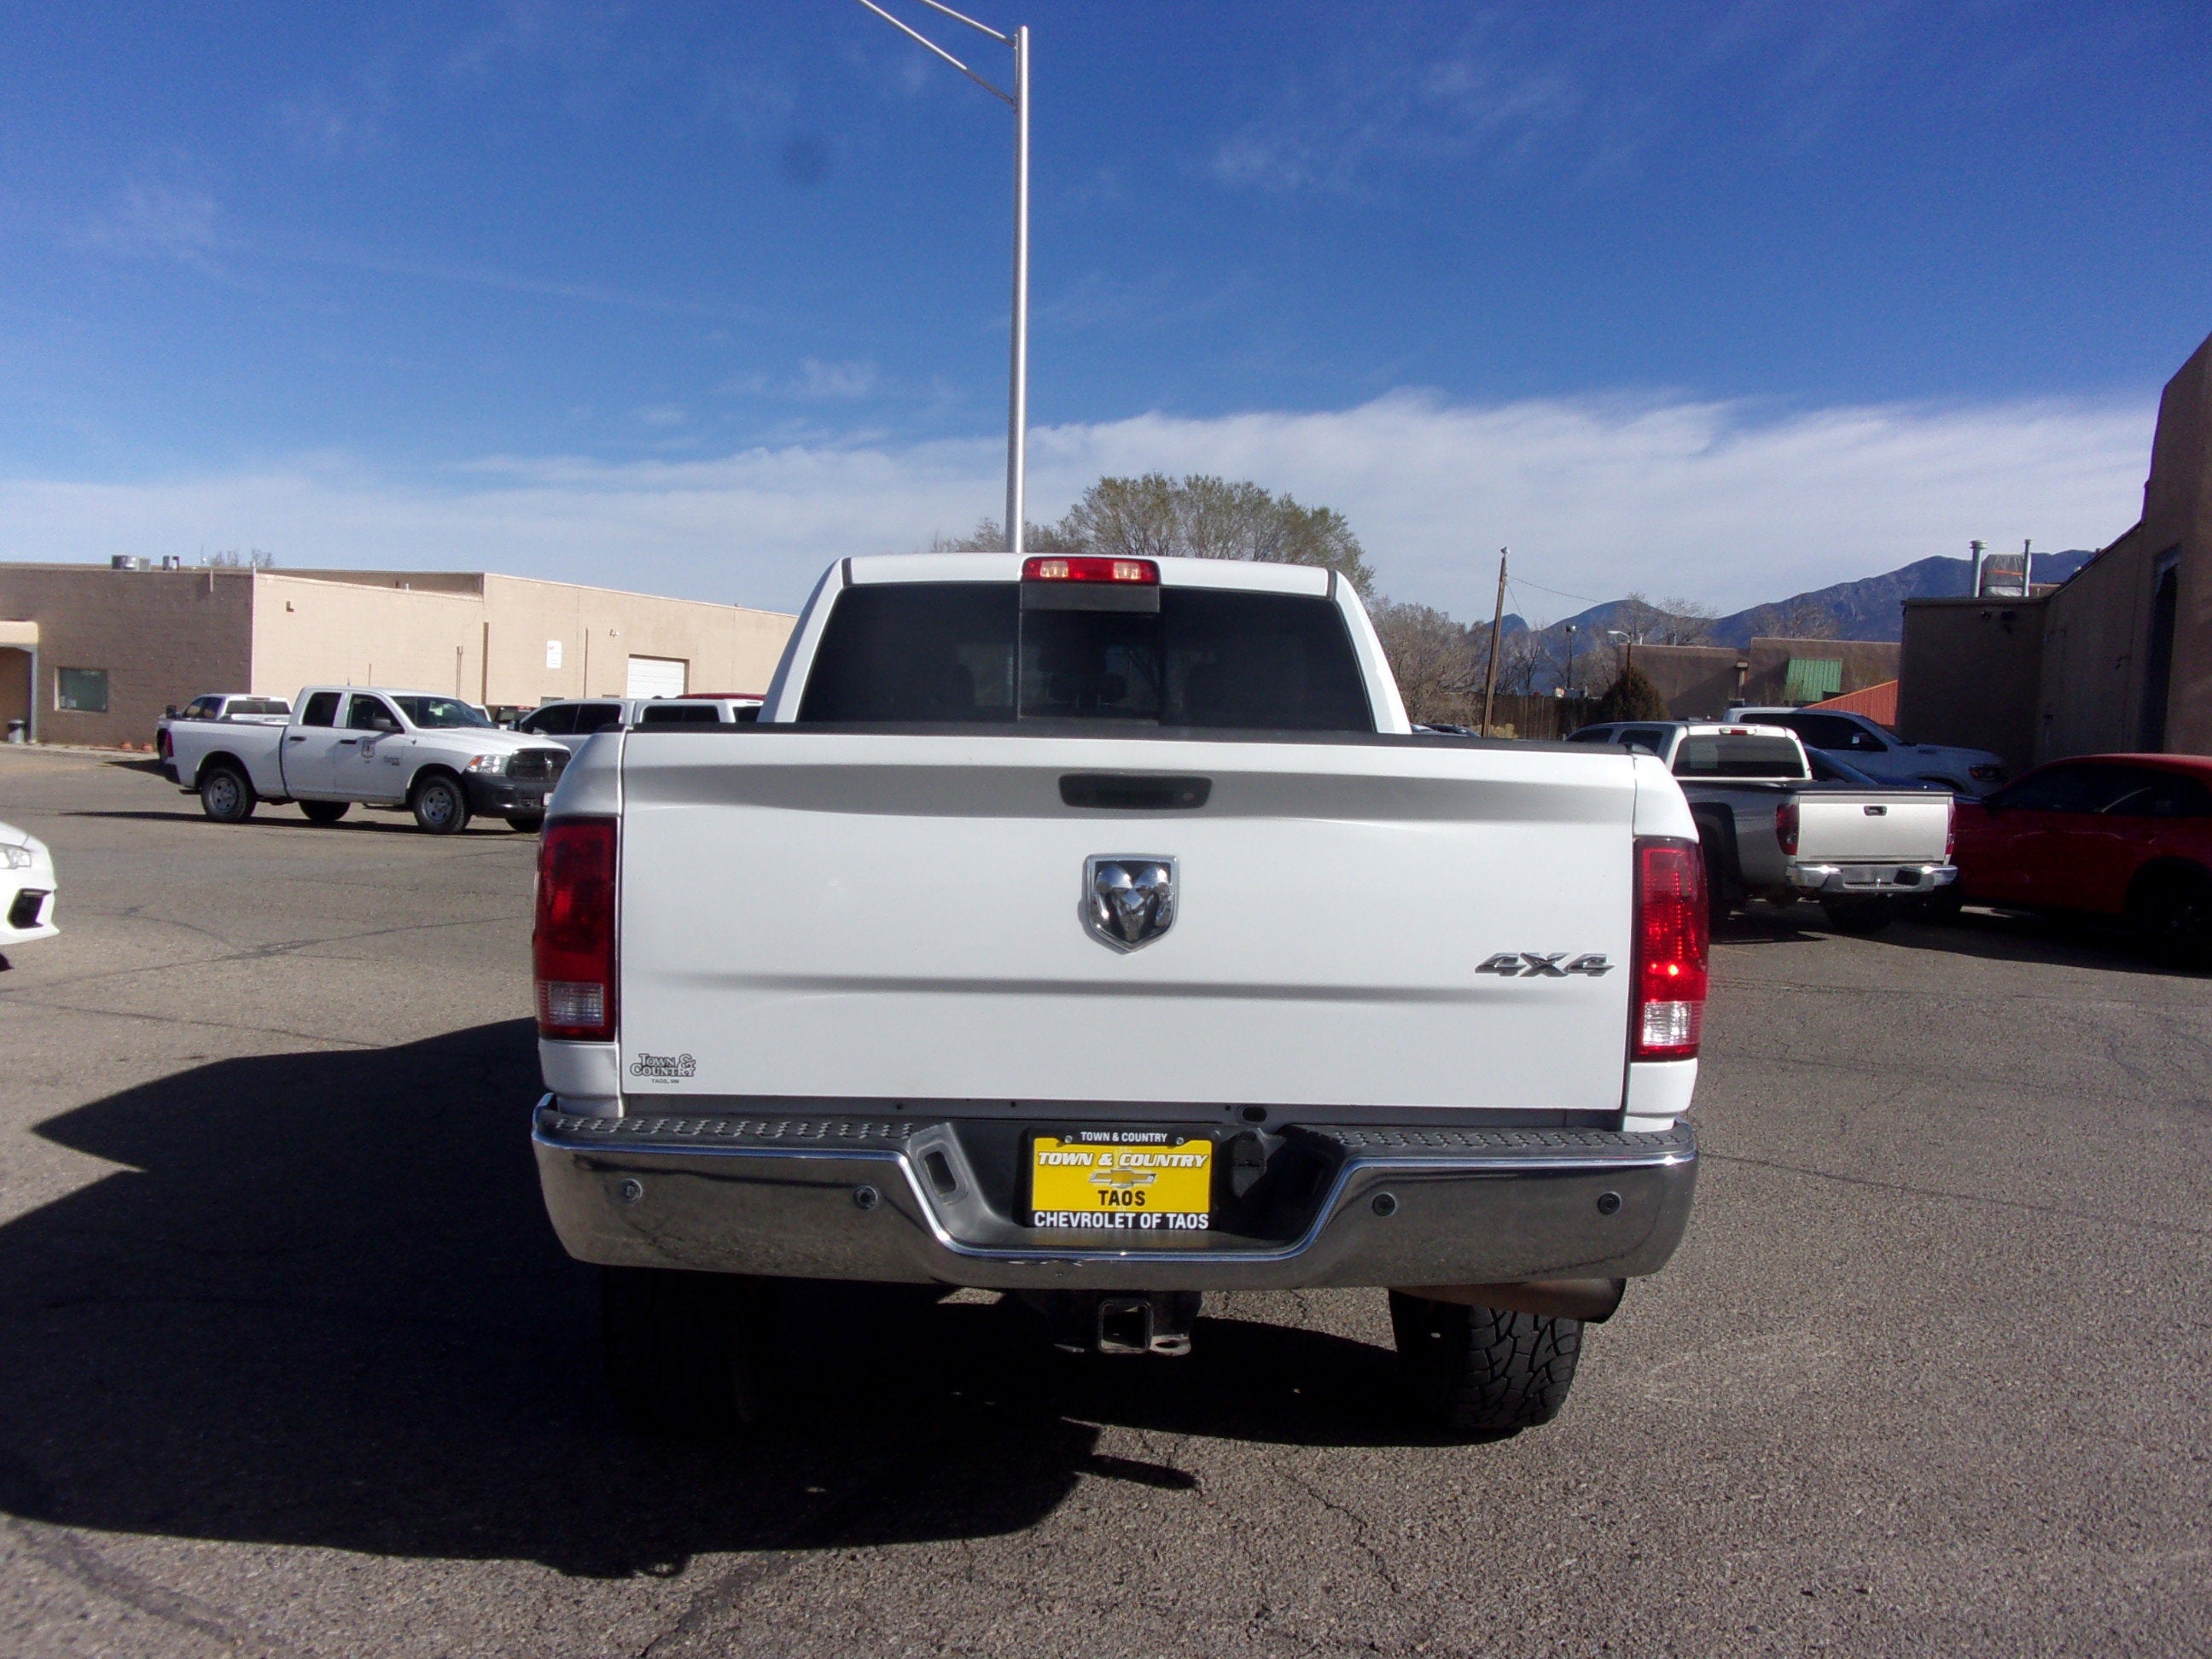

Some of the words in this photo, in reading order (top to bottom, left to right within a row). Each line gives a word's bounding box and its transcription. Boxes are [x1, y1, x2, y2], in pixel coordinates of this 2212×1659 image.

[638, 1052, 675, 1067] TOWN
[630, 1062, 696, 1077] COUNTRY
[1080, 1132, 1109, 1142] TOWN
[1112, 1132, 1120, 1143] &
[1121, 1132, 1167, 1143] COUNTRY
[1038, 1151, 1093, 1166] TOWN
[1097, 1153, 1113, 1166] &
[1119, 1153, 1208, 1167] COUNTRY
[1097, 1190, 1146, 1207] TAOS
[1033, 1212, 1136, 1229] CHEVROLET
[1140, 1213, 1162, 1229] OF
[1167, 1213, 1209, 1230] TAOS
